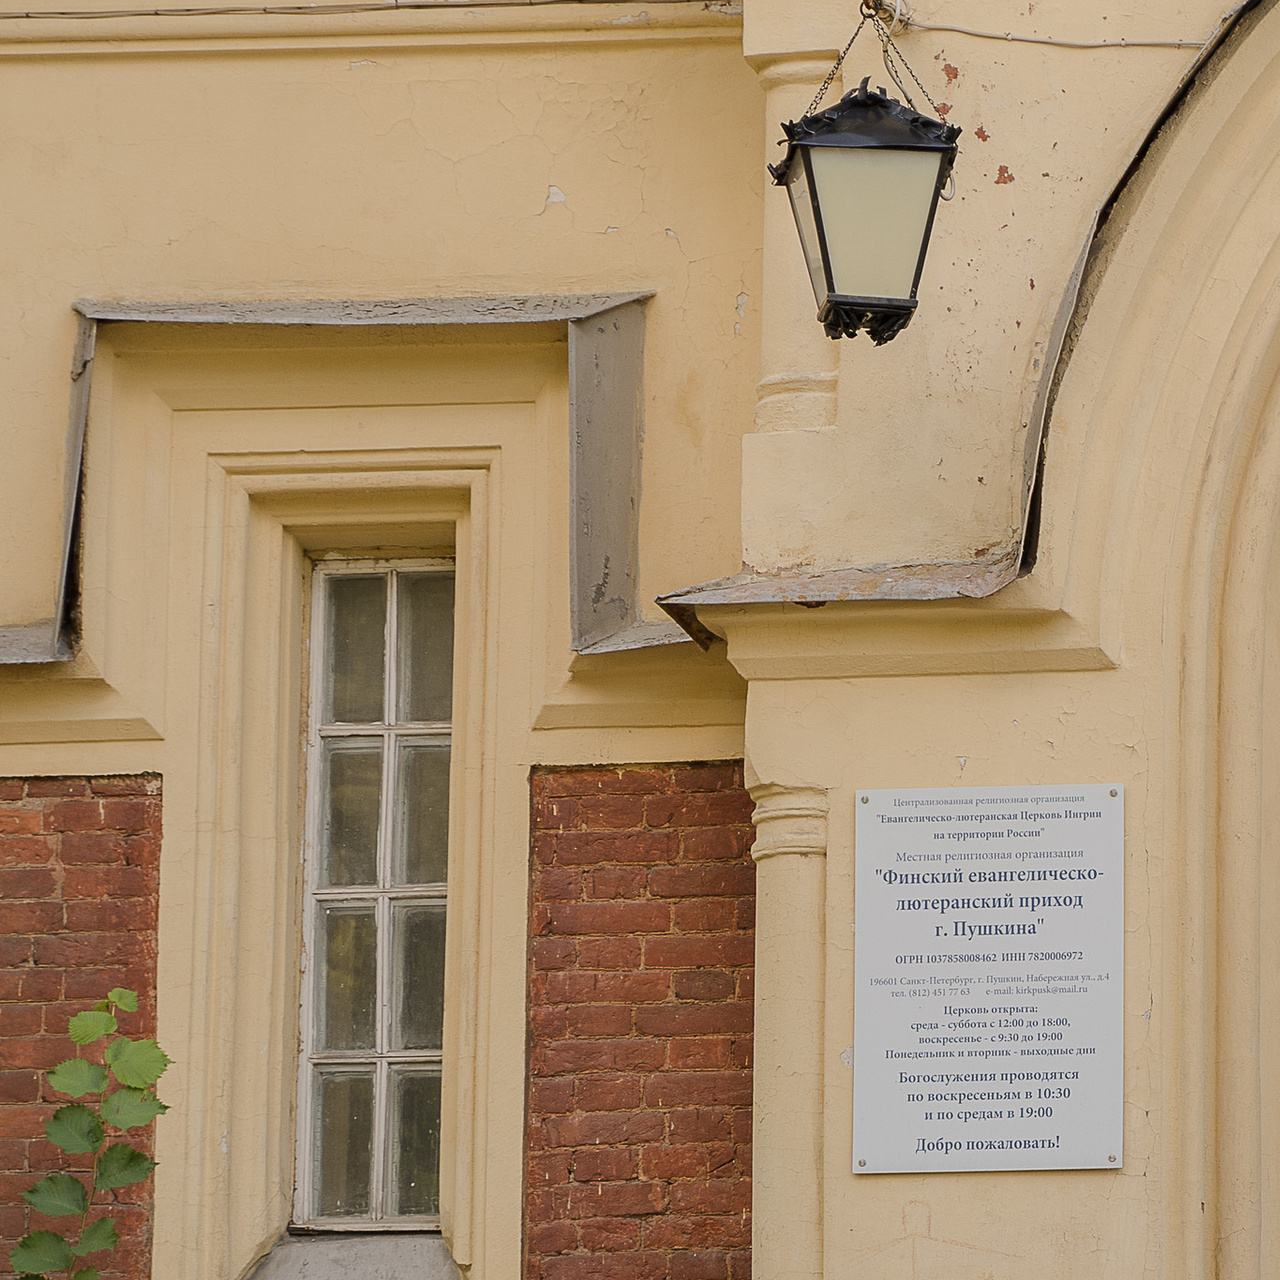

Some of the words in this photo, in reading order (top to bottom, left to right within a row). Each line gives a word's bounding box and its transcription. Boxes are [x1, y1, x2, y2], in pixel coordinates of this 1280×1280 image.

[876, 813, 1018, 823] "Евангелическо-лютеранская
[1020, 810, 1063, 822] Церковь
[1064, 809, 1102, 820] Ингрии
[933, 832, 945, 840] на
[947, 831, 1005, 841] территории
[1006, 827, 1045, 837] России"
[895, 851, 942, 861] Местная
[944, 852, 1013, 863] религиозная
[1014, 850, 1084, 861] организация
[875, 867, 964, 884] "Финский
[968, 868, 1104, 882] евангелическо-
[895, 892, 1014, 914] лютеранский
[1018, 895, 1084, 912] приход
[934, 925, 948, 936] г.
[953, 917, 1045, 940] Пушкина"
[895, 954, 924, 964] ОГРН
[926, 953, 997, 963] 1037858008462
[1001, 952, 1026, 962] ИНН
[1027, 951, 1084, 961] 7820006972
[943, 1005, 989, 1017] Церковь
[990, 1005, 1038, 1015] открыта:
[910, 1022, 939, 1032] среда
[947, 1018, 988, 1031] суббота
[998, 1018, 1025, 1028] 12:00
[1025, 1020, 1039, 1029] до
[1042, 1017, 1071, 1027] 18:00,
[918, 1036, 982, 1046] воскресенье
[990, 1035, 997, 1043] с
[997, 1033, 1020, 1043] 9:30
[1020, 1034, 1034, 1043] до
[1037, 1031, 1063, 1041] 19:00
[885, 1049, 956, 1059] Понедельник
[957, 1050, 965, 1058] и
[967, 1049, 1012, 1059] вторник
[1020, 1048, 1075, 1057] выходные
[1075, 1047, 1096, 1056] дни
[899, 1071, 997, 1085] Богослужения
[1000, 1071, 1079, 1084] проводятся
[907, 1093, 924, 1102] по
[927, 1091, 1021, 1104] воскресеньям
[1024, 1091, 1033, 1100] в
[1037, 1087, 1071, 1099] 10:30
[924, 1111, 933, 1121] и
[937, 1111, 954, 1120] по
[956, 1110, 1003, 1122] средам
[1006, 1110, 1015, 1119] в
[1019, 1106, 1053, 1118] 19:00
[915, 1136, 963, 1154] Добро
[966, 1135, 1060, 1150] пожаловать!
